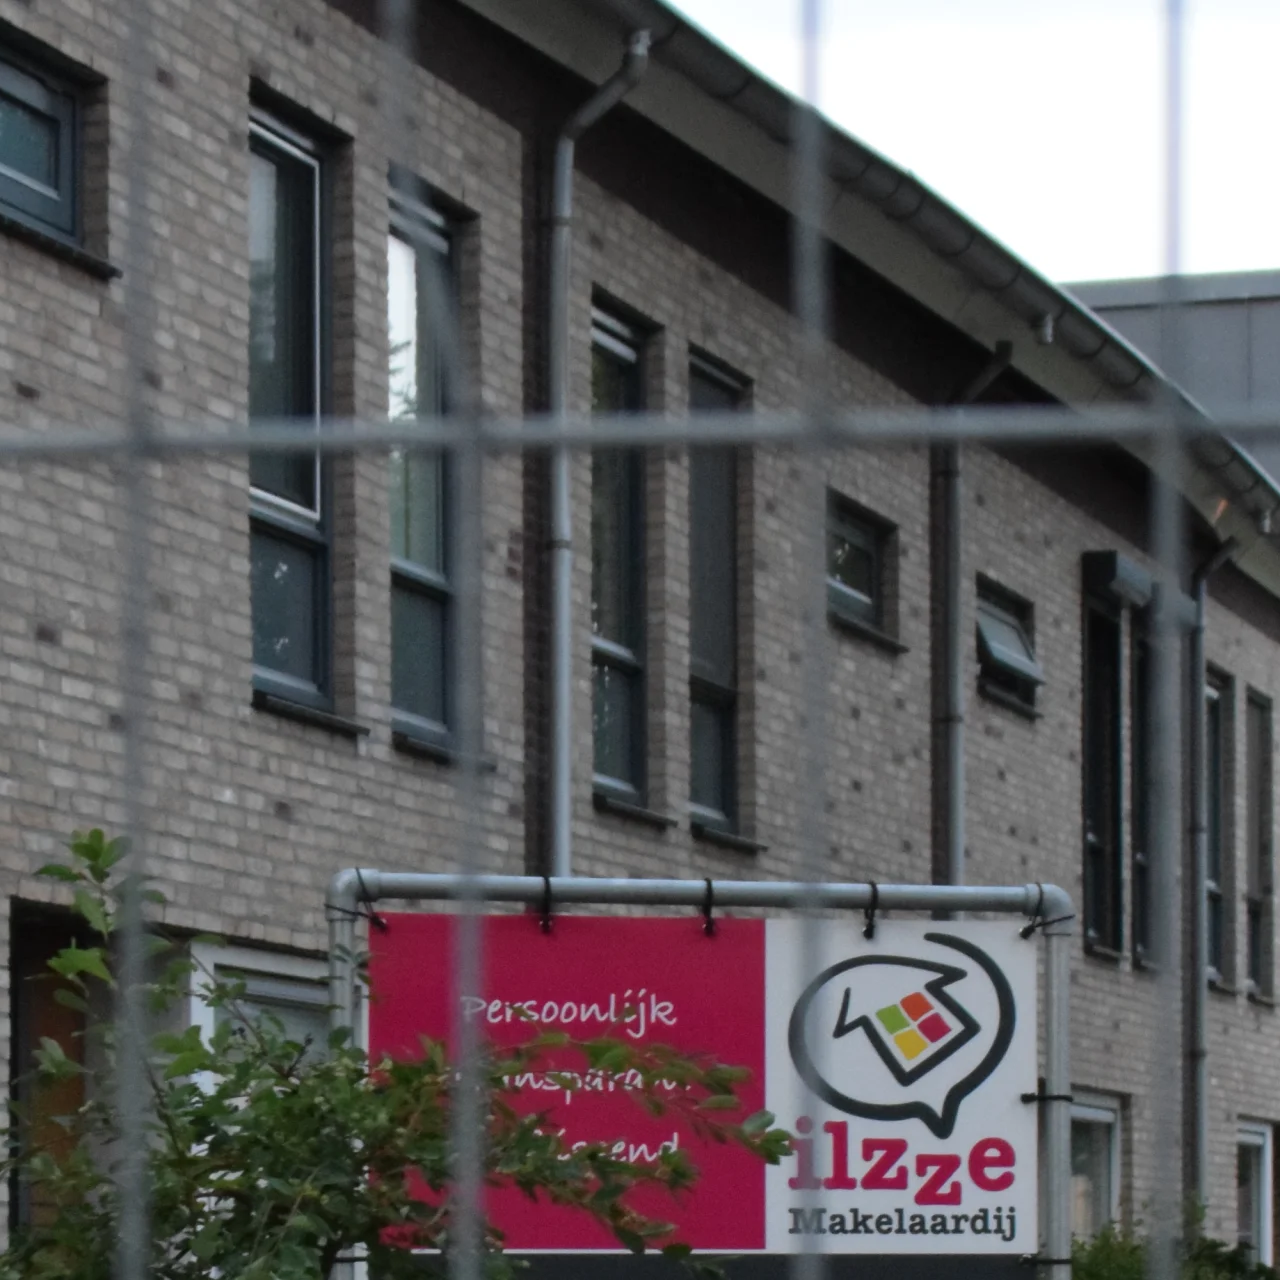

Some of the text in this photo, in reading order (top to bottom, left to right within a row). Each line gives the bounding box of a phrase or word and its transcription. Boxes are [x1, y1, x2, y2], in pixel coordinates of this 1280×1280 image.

[460, 988, 678, 1039] Persoonlijk
[787, 1115, 1017, 1206] ilzze
[788, 1206, 1017, 1242] Makelaardij
